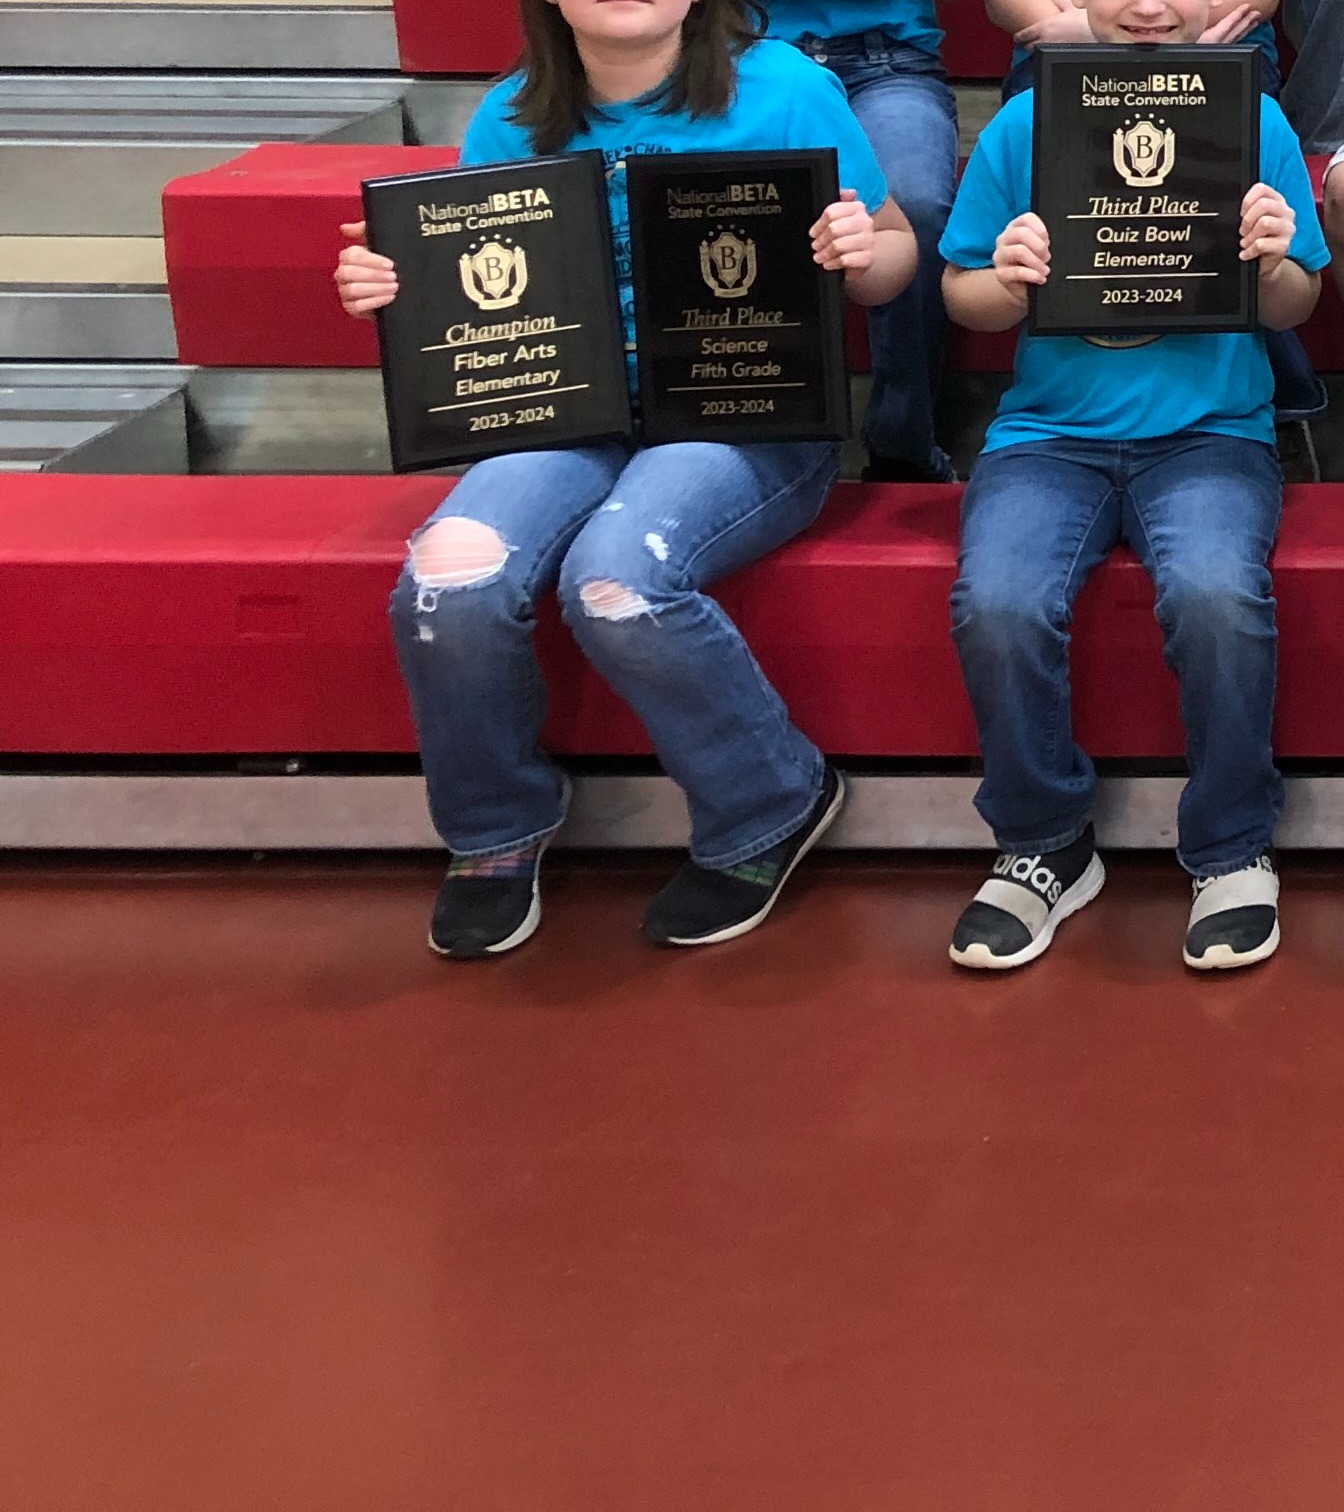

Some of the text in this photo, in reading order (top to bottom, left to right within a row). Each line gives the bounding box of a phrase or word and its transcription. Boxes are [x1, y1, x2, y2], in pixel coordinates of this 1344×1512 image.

[1082, 74, 1205, 92] NationalBETA
[1082, 94, 1206, 106] State Convention
[667, 183, 779, 204] NationalBETA
[418, 187, 550, 221] NationalBETA
[667, 203, 782, 219] State Convention
[1088, 196, 1199, 216] Third Place
[420, 208, 553, 237] State Convention
[1096, 225, 1190, 244] Quiz Bowl
[1094, 252, 1192, 270] Elementary
[1102, 289, 1182, 304] 2023-2024
[681, 307, 783, 327] Third Place
[445, 312, 556, 345] Champion
[701, 338, 768, 355] Science
[454, 342, 556, 372] Fiber Arts
[691, 361, 781, 379] Fifth Grade
[456, 368, 561, 397] Elementary
[701, 399, 775, 415] 2023-2024
[469, 406, 554, 432] 2023-2024
